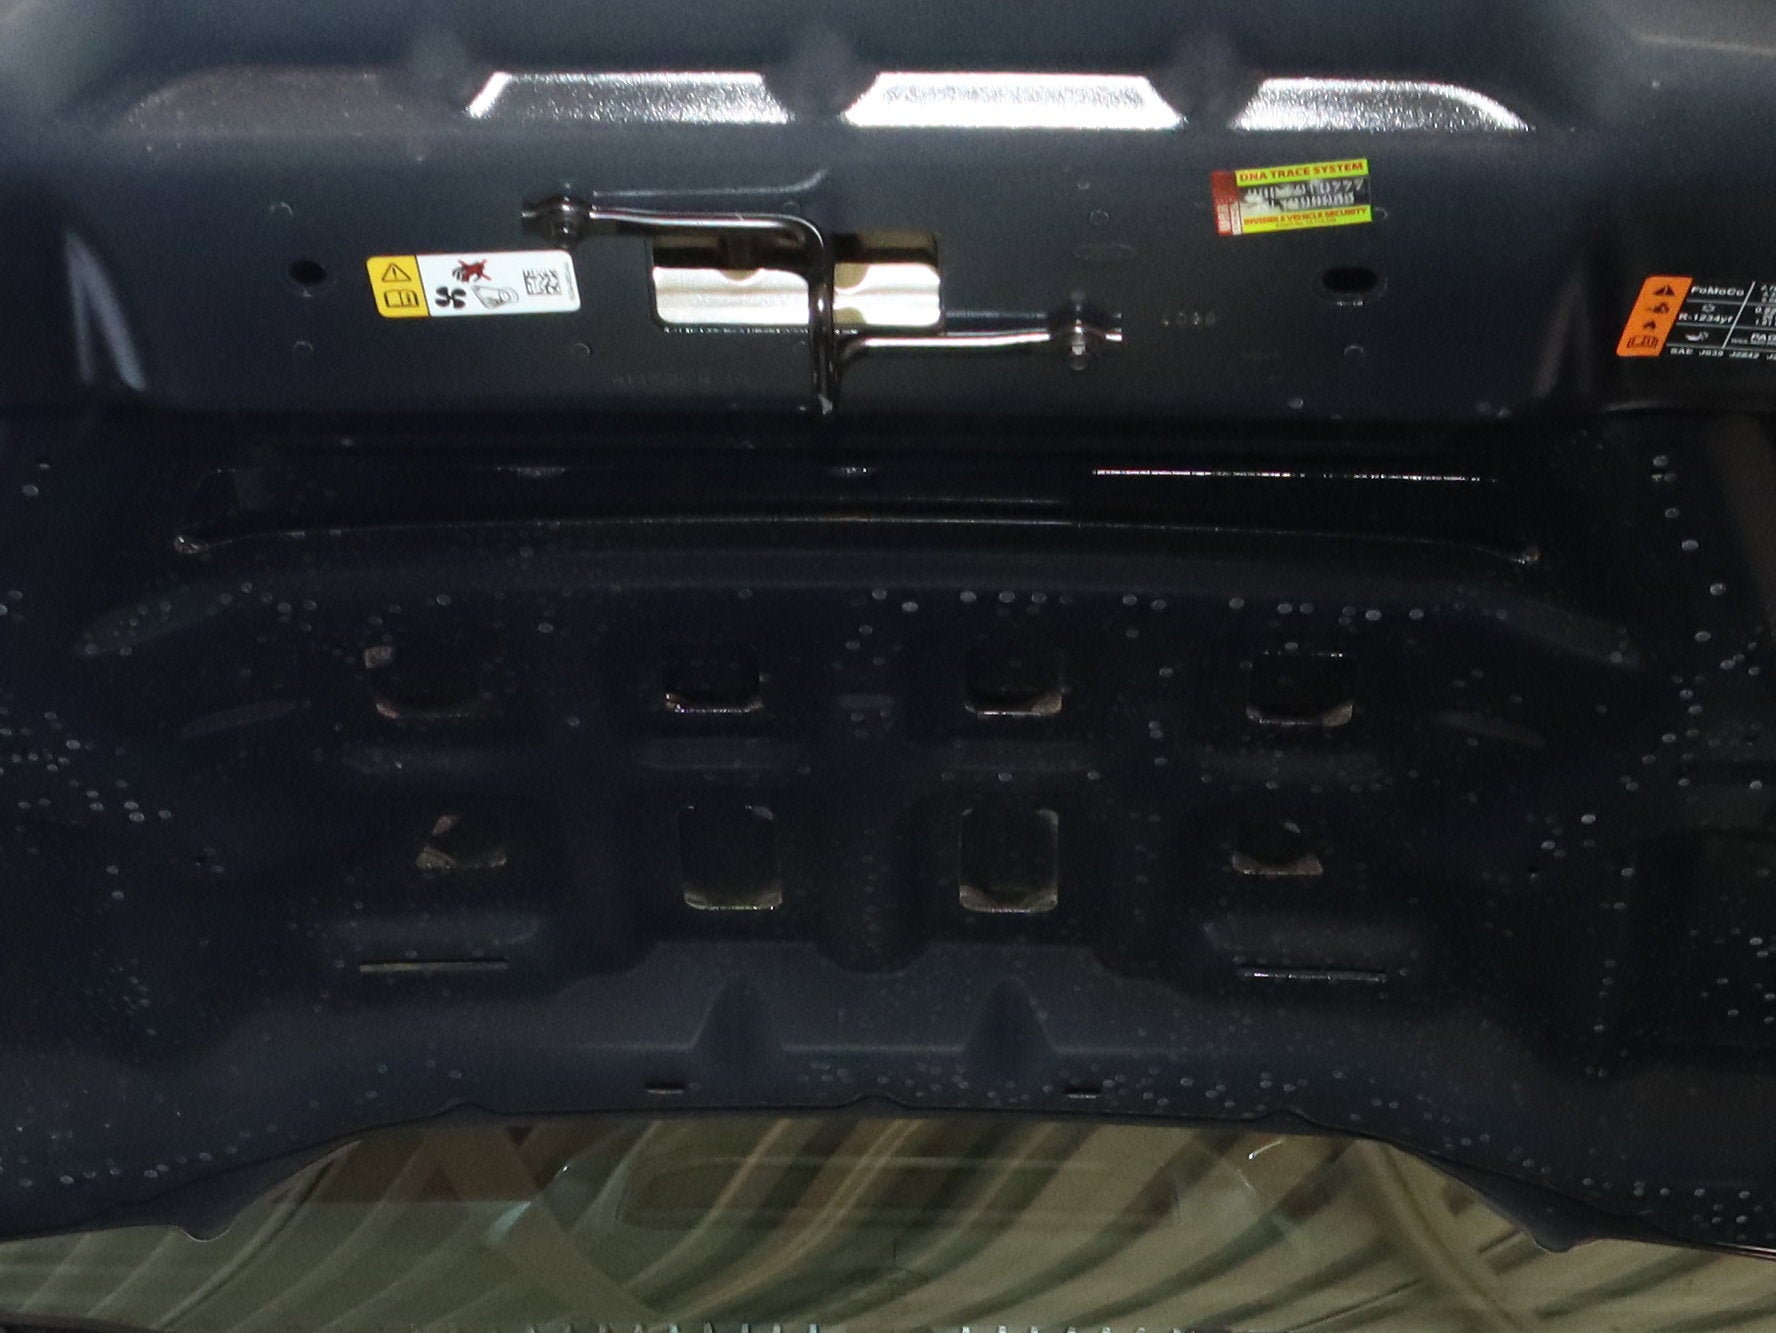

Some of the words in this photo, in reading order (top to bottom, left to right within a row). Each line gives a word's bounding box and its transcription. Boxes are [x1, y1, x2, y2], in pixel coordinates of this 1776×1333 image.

[1239, 172, 1268, 183] DNA
[1271, 167, 1310, 179] TRACE
[1313, 162, 1365, 175] SYSTEM
[1690, 285, 1745, 297] FoMoCo
[1677, 313, 1734, 324] R-1234yf
[1670, 347, 1694, 356] SAE
